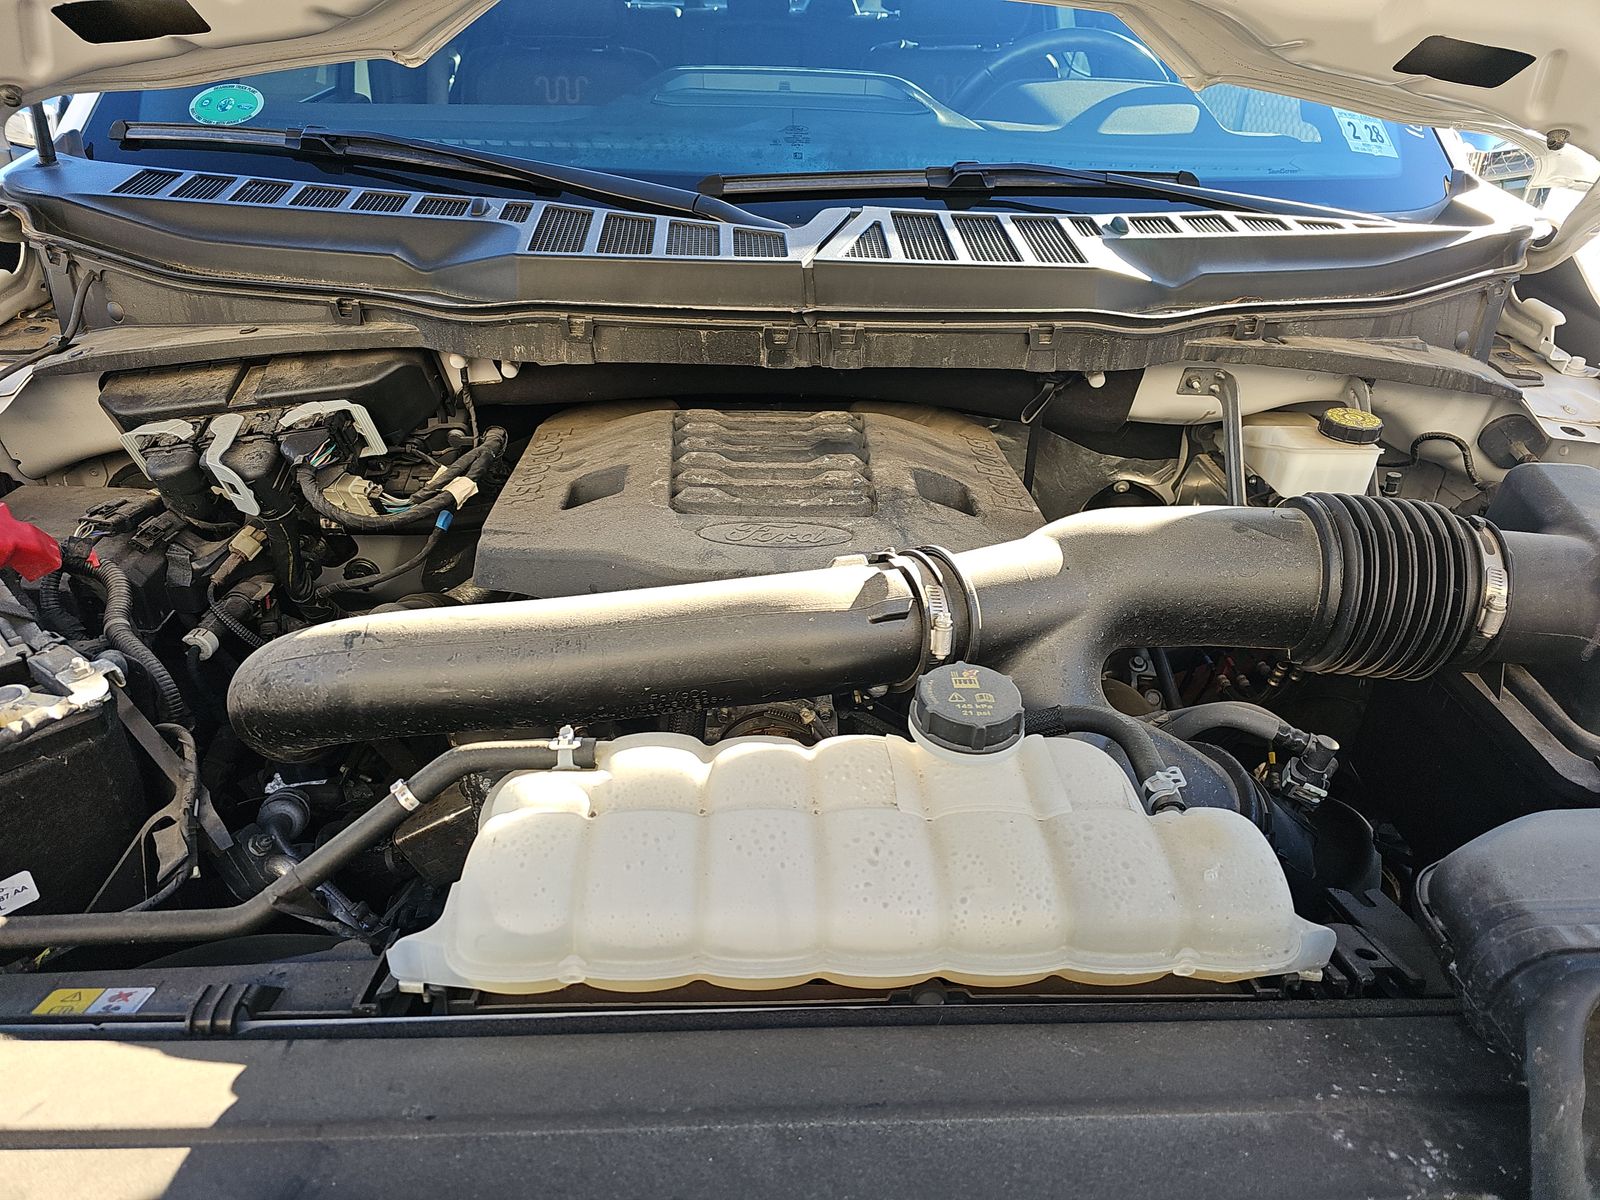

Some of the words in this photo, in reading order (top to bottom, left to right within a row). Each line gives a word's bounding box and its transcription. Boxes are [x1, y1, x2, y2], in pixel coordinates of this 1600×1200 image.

[1347, 121, 1361, 140] 2
[1364, 124, 1384, 143] 28
[724, 522, 826, 543] Ford
